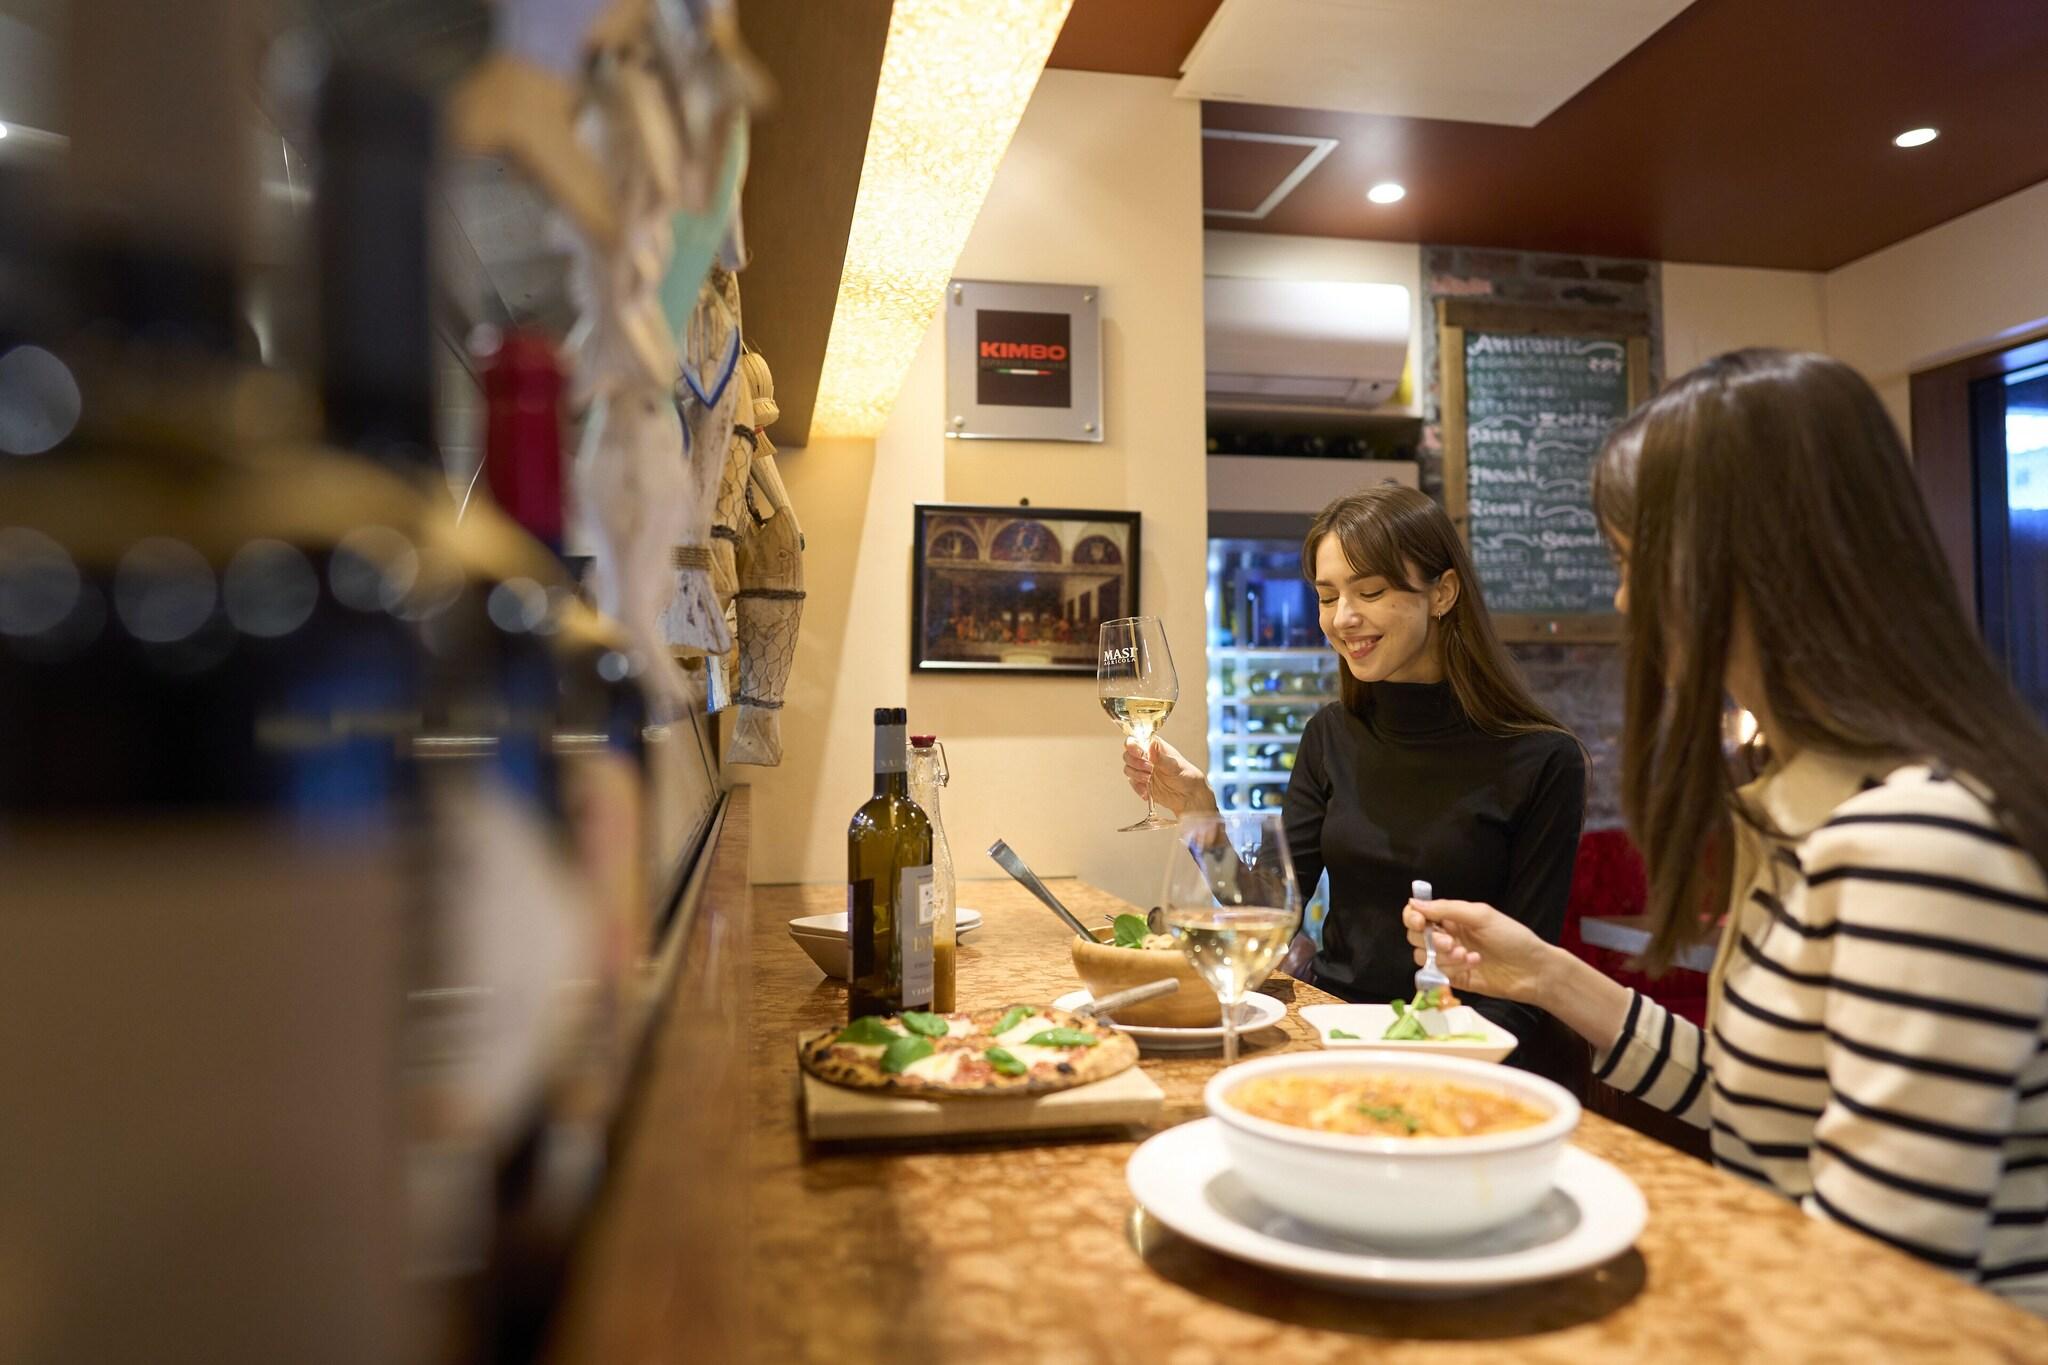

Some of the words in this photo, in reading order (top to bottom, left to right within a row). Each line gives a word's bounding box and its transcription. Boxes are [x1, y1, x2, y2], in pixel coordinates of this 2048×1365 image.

[980, 341, 1067, 361] KIMBO
[1104, 647, 1137, 661] MASI
[1104, 657, 1136, 666] AGRICOLA
